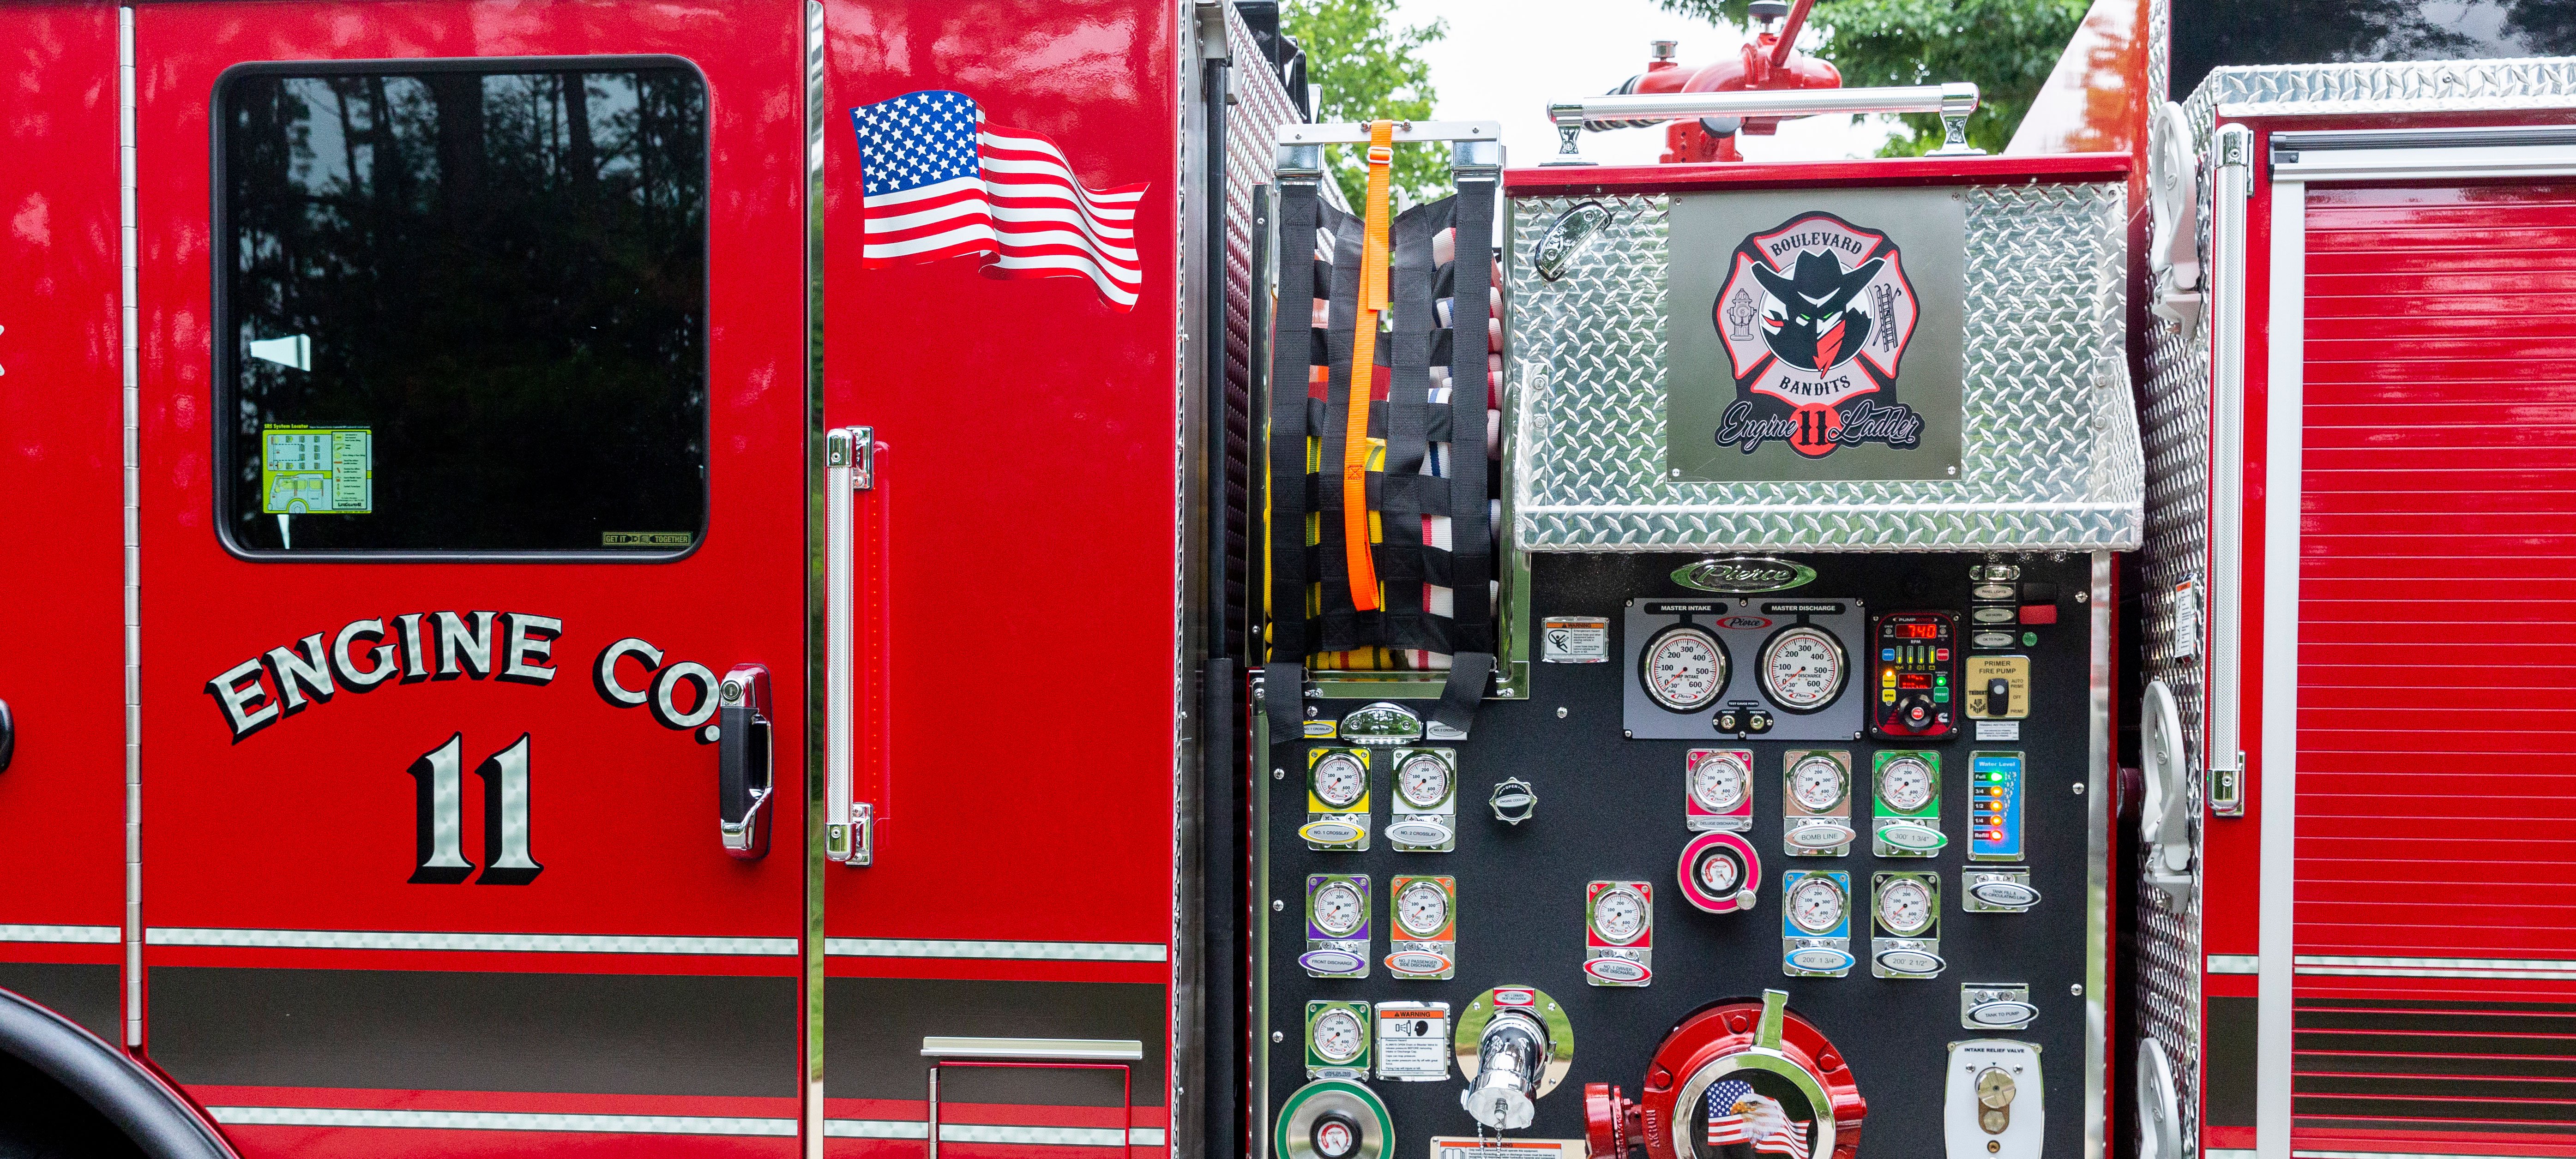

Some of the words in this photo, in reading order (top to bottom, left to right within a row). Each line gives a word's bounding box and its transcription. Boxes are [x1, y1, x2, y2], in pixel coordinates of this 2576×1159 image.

[1769, 232, 1863, 257] BOULEVARD
[1779, 375, 1851, 396] BANDITS
[1717, 401, 1799, 450] Engine
[1798, 410, 1831, 446] 11
[1827, 399, 1920, 444] Ladder
[1697, 564, 1791, 583] Pierce
[1730, 618, 1762, 626] Pierce
[1908, 625, 1936, 638] 740
[205, 611, 563, 744] ENGINE
[592, 637, 720, 745] CO.
[1969, 703, 1986, 714] PRIME
[1974, 699, 1982, 708] AIR
[407, 732, 544, 885] 11
[1645, 1110, 1660, 1147] AKRON
